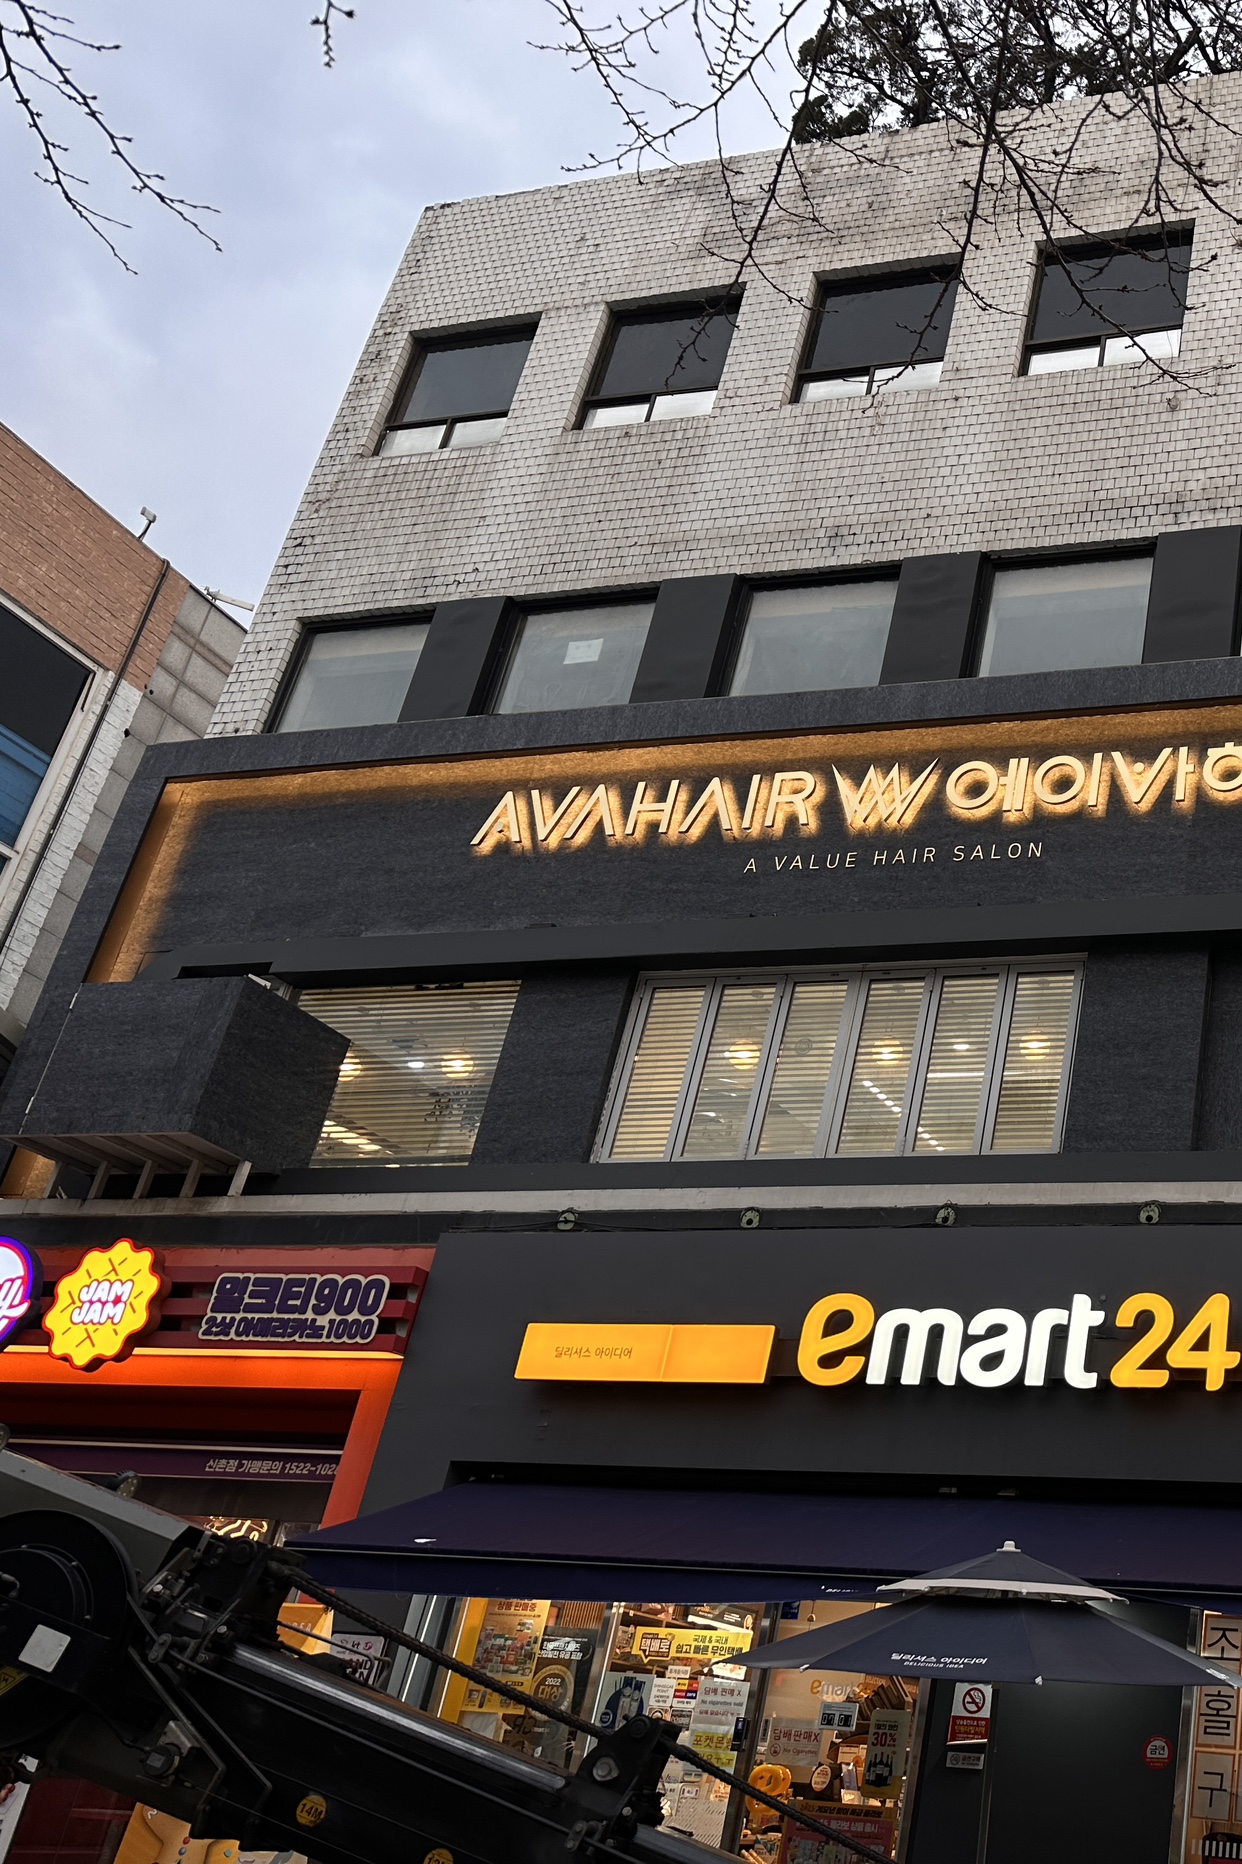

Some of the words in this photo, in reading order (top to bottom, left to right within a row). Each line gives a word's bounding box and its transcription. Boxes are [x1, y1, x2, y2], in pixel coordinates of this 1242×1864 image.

[470, 771, 816, 845] AVAHAIR
[743, 858, 758, 874] A
[775, 852, 858, 872] VALUE
[873, 847, 937, 867] HAIR
[953, 842, 1044, 862] SALON
[79, 1279, 135, 1302] JAM
[70, 1302, 127, 1325] JAM
[797, 1292, 1241, 1392] emart24
[554, 1345, 592, 1359] 딜리셔스
[594, 1346, 633, 1360] 아이디어
[205, 1458, 239, 1473] 신촌점
[238, 1460, 284, 1475] 가맹문의
[640, 1637, 671, 1655] 택배로
[675, 1643, 692, 1654] 쉽고
[940, 1656, 989, 1665] 아이디어
[545, 1677, 561, 1686] 2022
[720, 1687, 735, 1697] 판매
